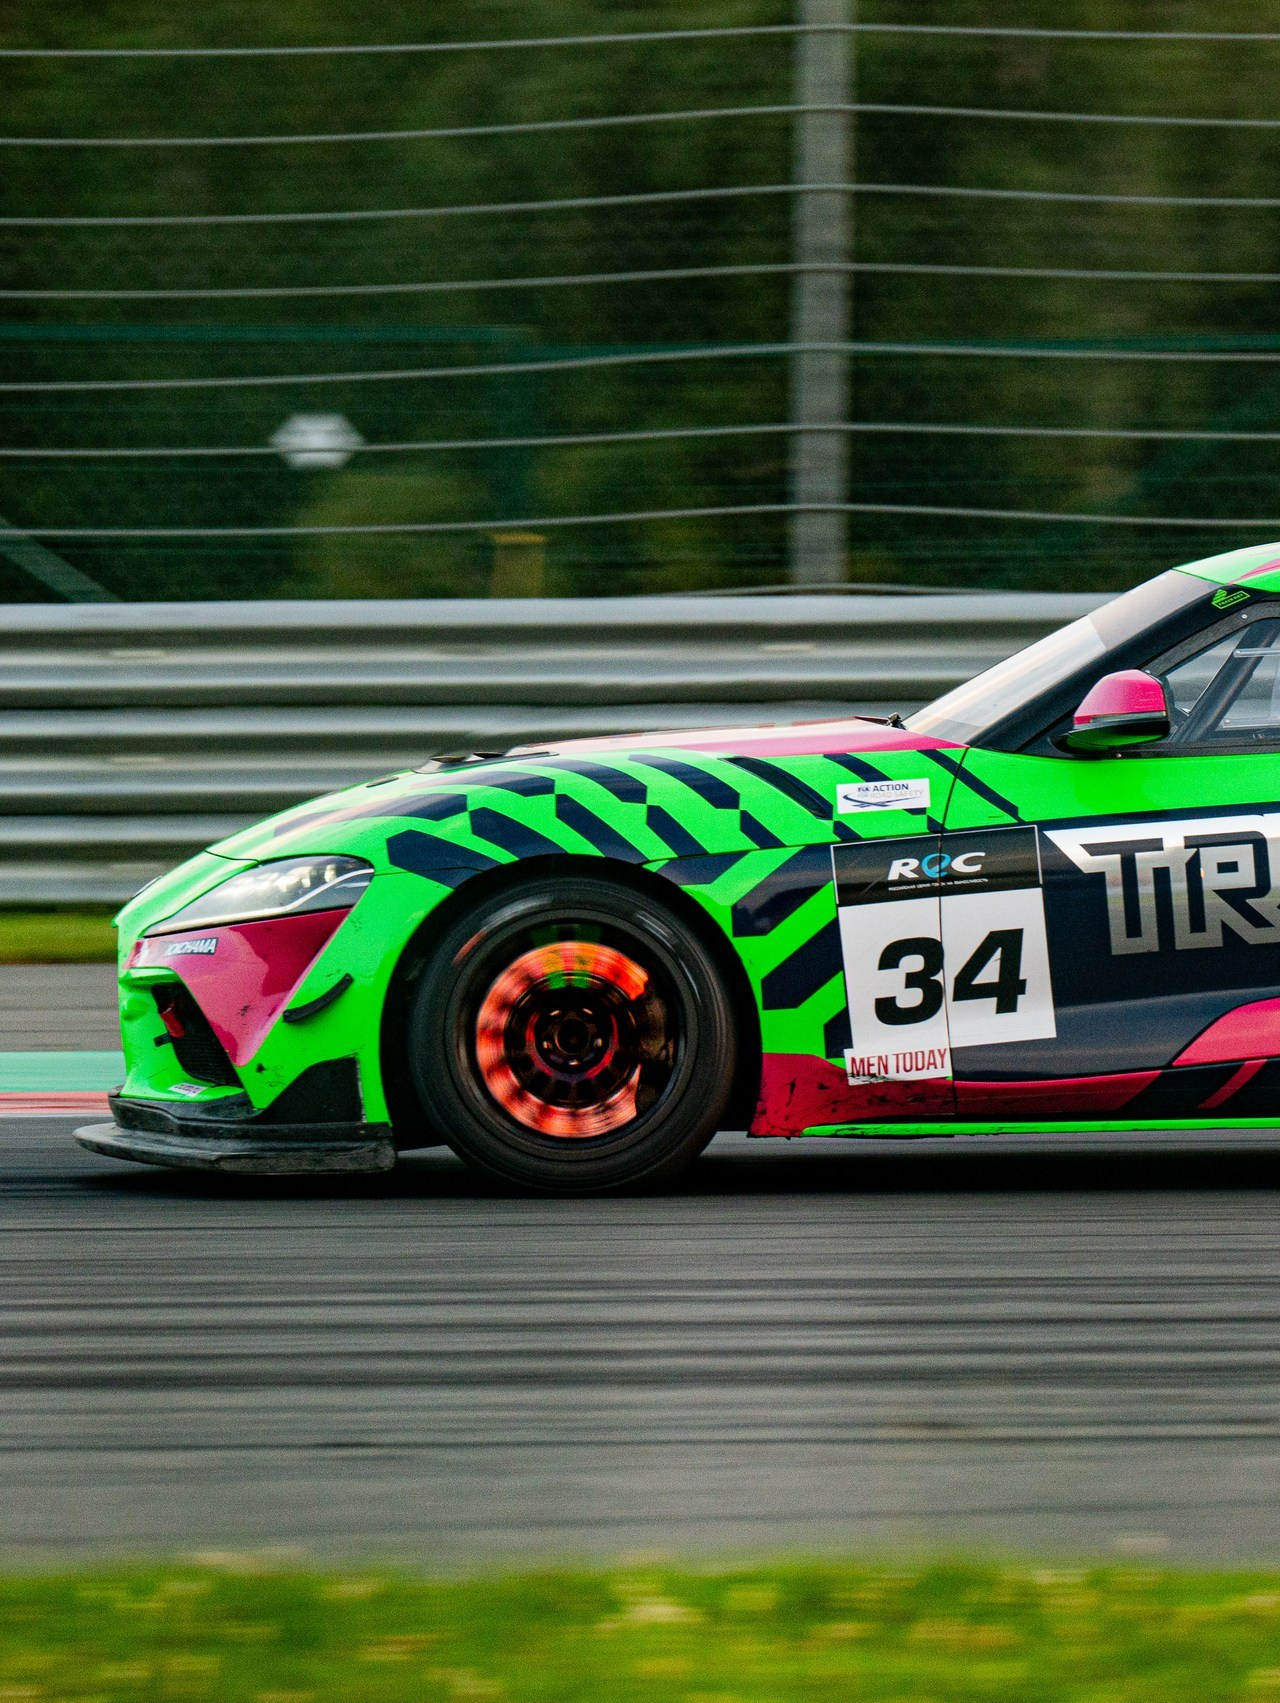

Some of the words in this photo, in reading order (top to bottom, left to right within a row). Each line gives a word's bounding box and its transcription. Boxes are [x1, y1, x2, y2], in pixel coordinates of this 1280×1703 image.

[872, 783, 909, 792] ACTION
[894, 789, 923, 797] SAFETY
[874, 928, 1027, 1026] 34
[850, 1054, 889, 1077] MEN
[891, 1048, 948, 1074] TODAY
